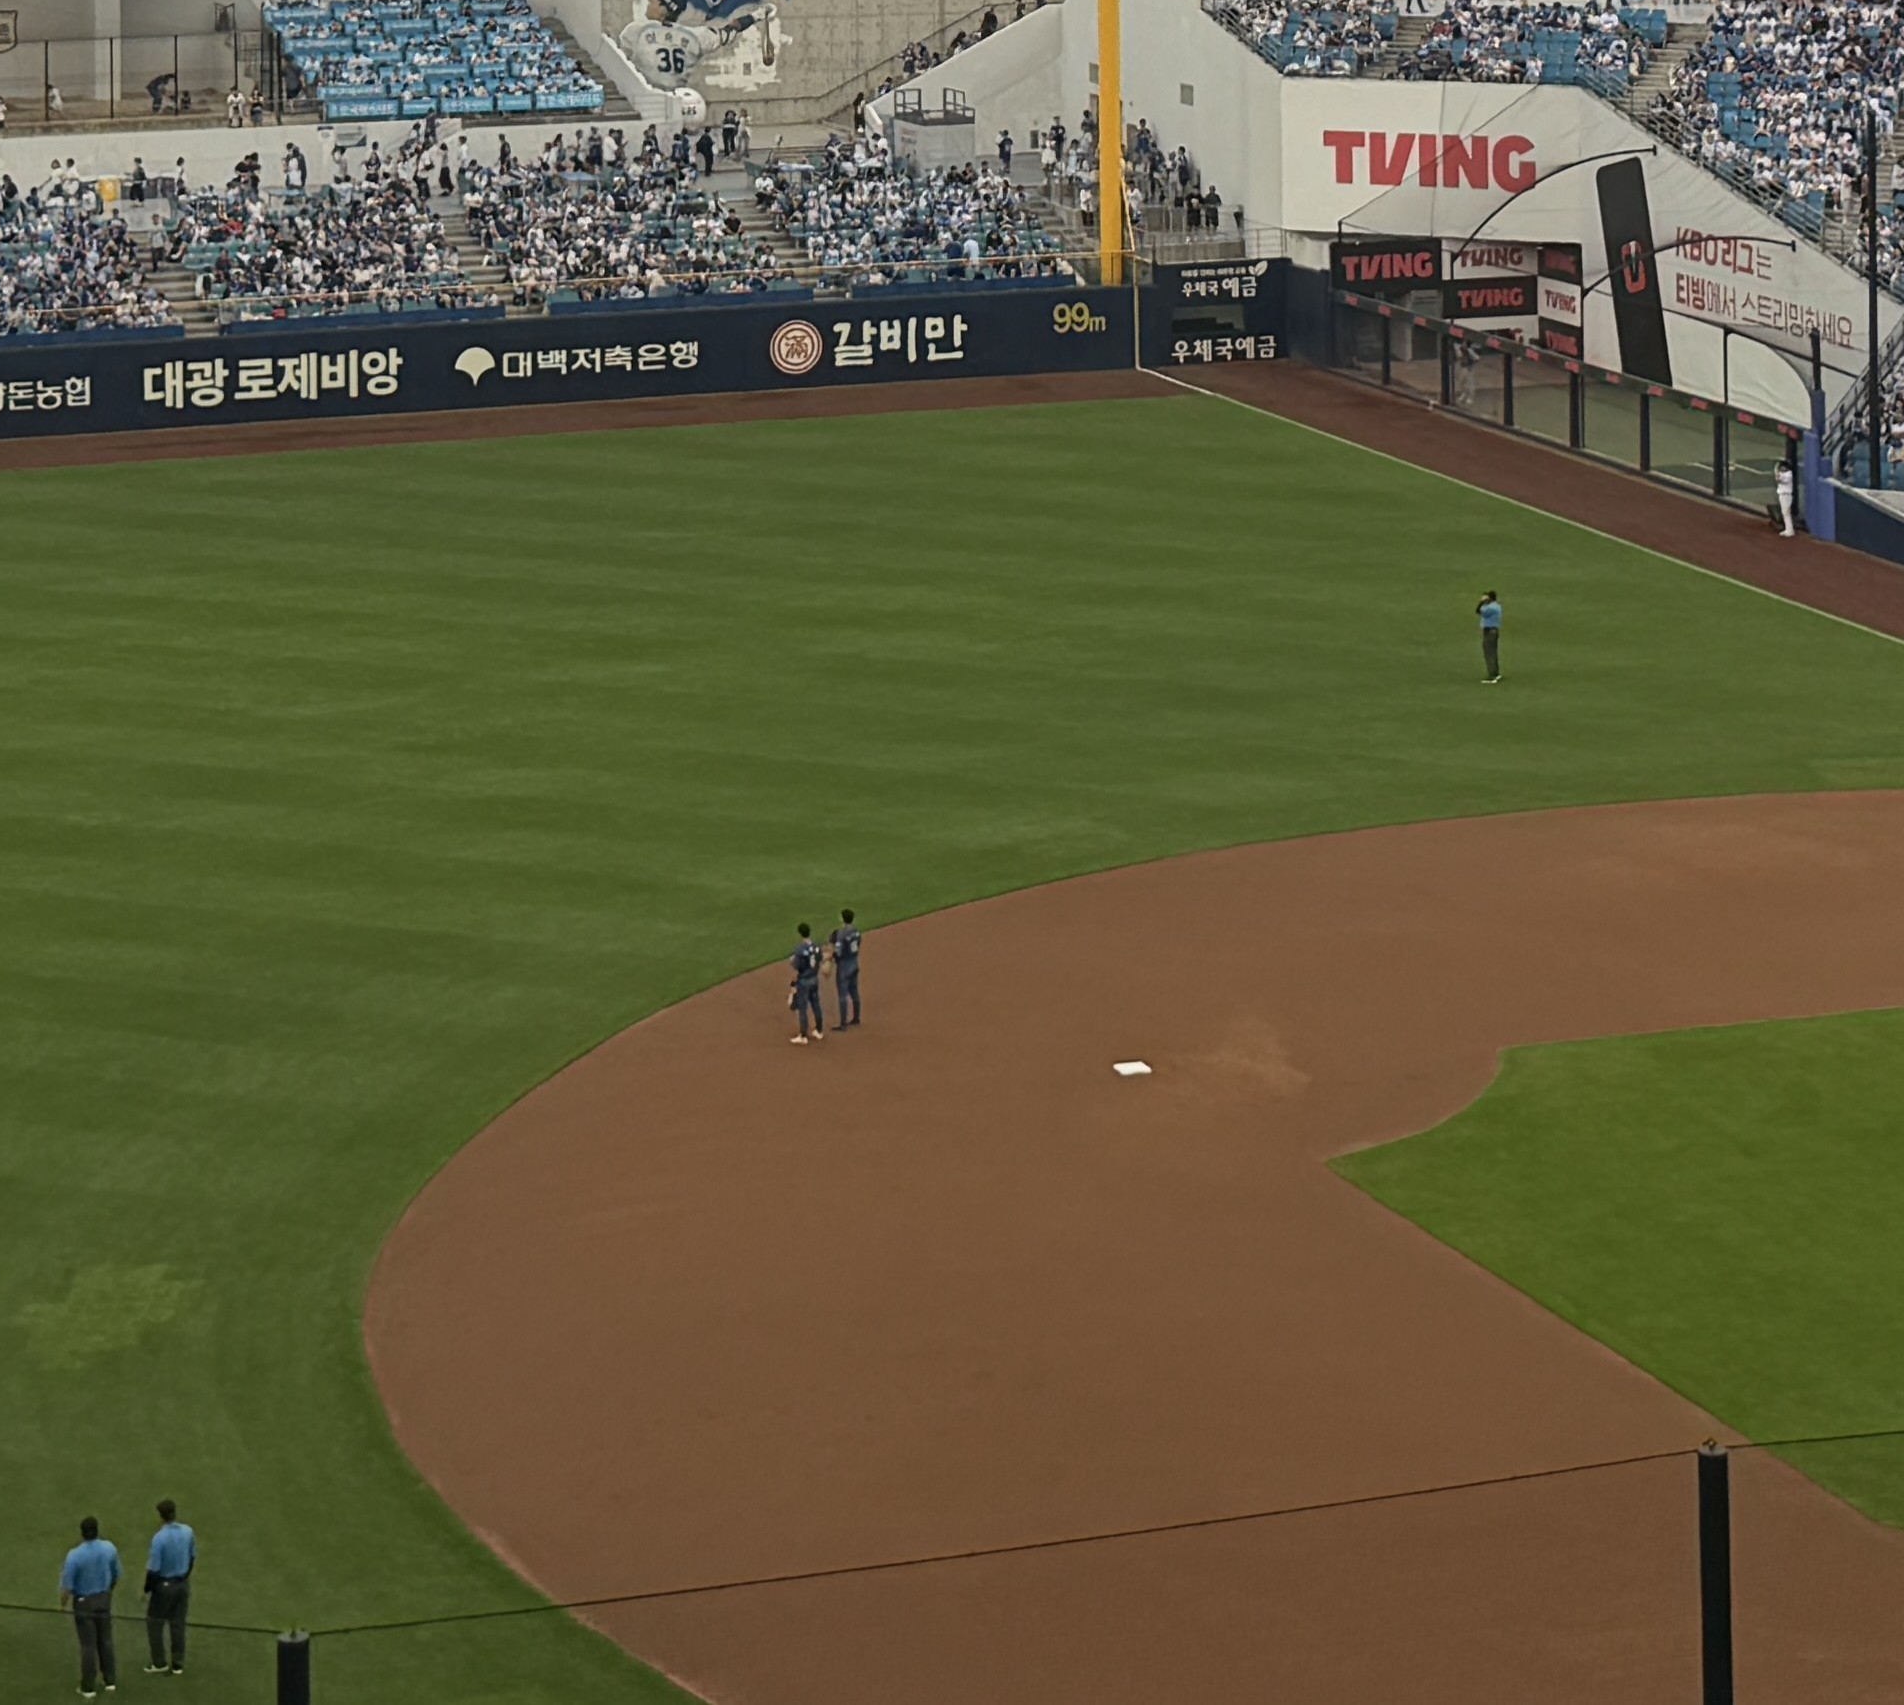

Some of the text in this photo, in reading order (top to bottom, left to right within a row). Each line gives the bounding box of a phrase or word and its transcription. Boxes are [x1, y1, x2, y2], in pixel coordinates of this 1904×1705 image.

[656, 48, 685, 74] 36
[1322, 130, 1537, 193] TVING
[1341, 252, 1434, 282] TVING
[1459, 246, 1524, 269] TVING
[1676, 226, 1772, 280] KBO리그는
[1052, 302, 1107, 333] 99m
[1457, 287, 1576, 314] TVING TVING
[1676, 272, 1852, 349] 티빙에서 스트리밍하세요
[502, 340, 699, 378] 대백저축은행
[832, 314, 969, 367] 갈비만
[1171, 335, 1277, 363] 우체국예금
